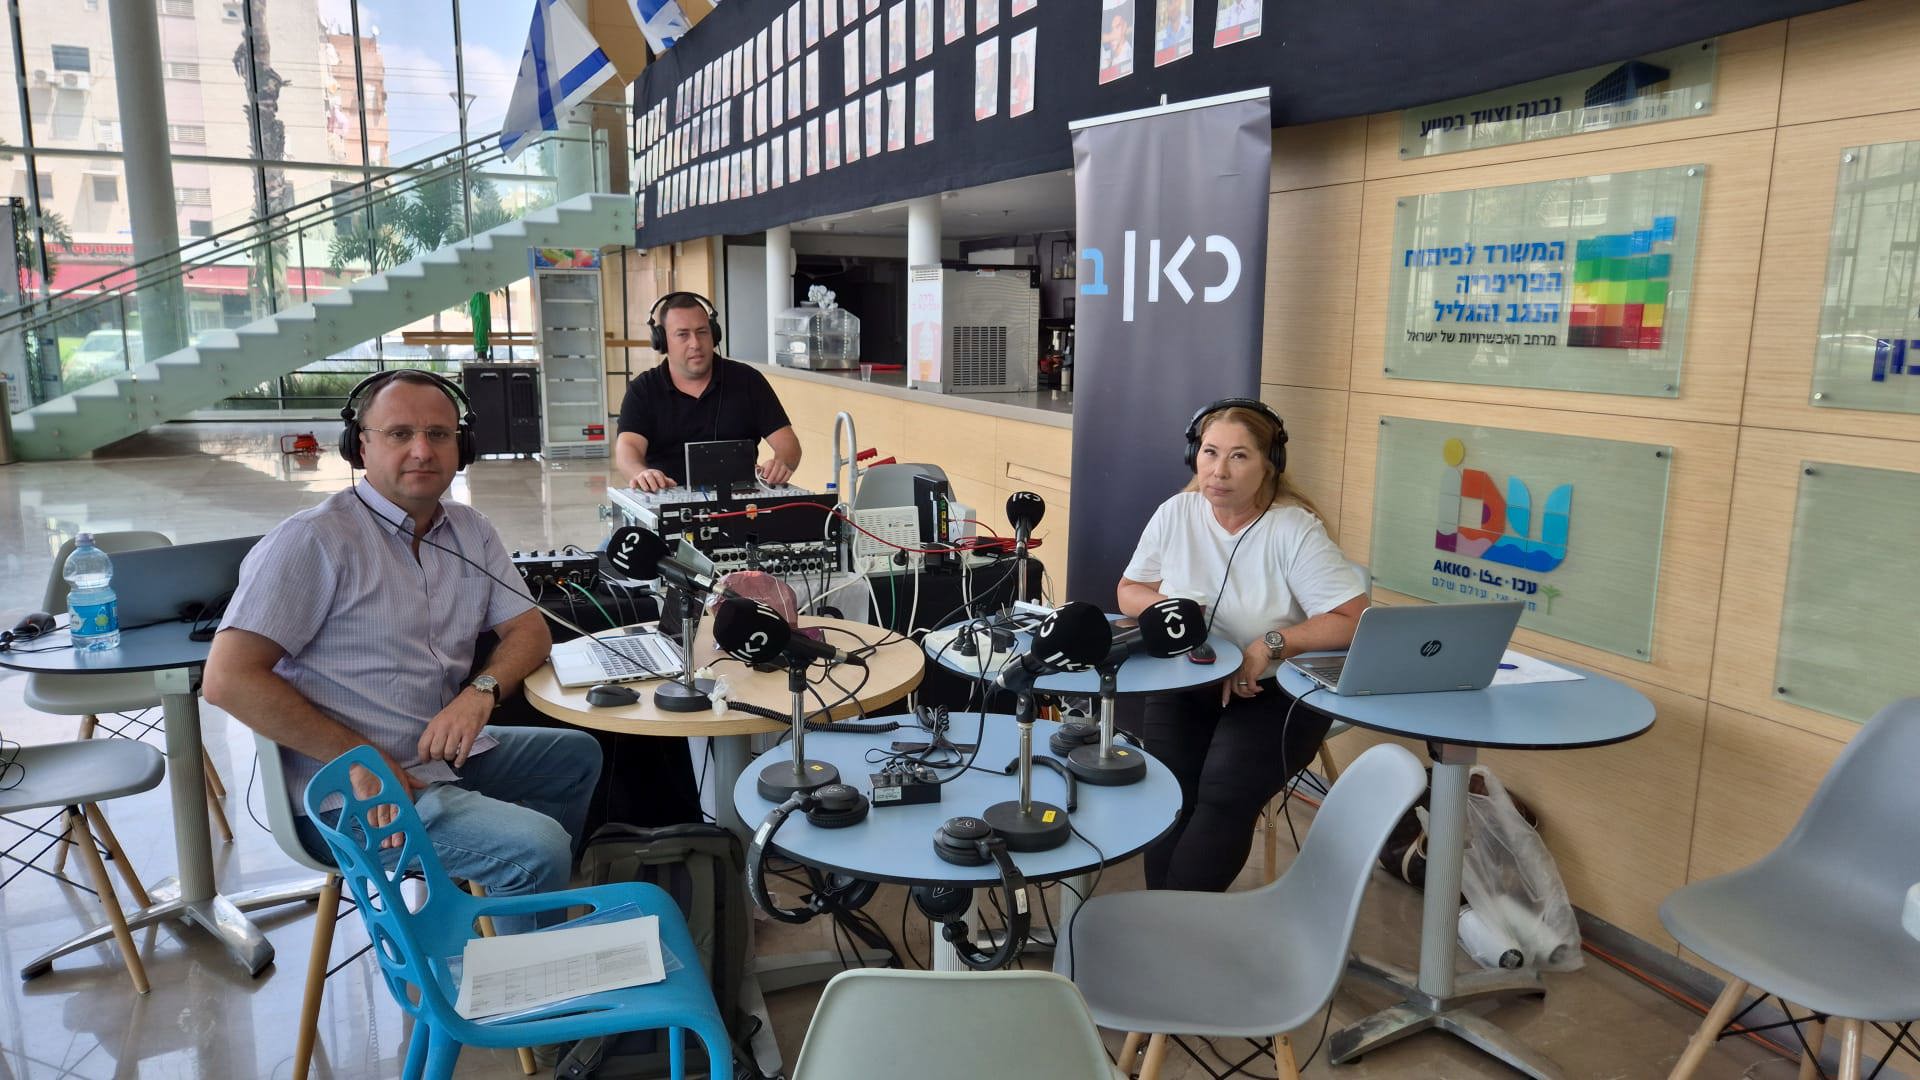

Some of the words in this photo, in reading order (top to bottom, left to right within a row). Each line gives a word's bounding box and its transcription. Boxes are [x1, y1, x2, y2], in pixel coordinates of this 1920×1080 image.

[1516, 96, 1563, 120] נבנה
[1404, 242, 1477, 267] לפיתוח
[1483, 241, 1566, 264] המשרד
[1080, 248, 1109, 295] ב
[1122, 230, 1242, 322] כאן
[1456, 272, 1562, 294] הפריפריה
[1434, 300, 1500, 322] והגליל
[1505, 303, 1560, 323] הנגב
[1406, 329, 1438, 342] ישראל
[1440, 330, 1456, 343] של
[1524, 333, 1556, 346] מרחב
[1433, 559, 1471, 579] AKKO
[1432, 576, 1455, 590] שלם
[1460, 583, 1488, 598] עולם
[1512, 577, 1538, 595] עכו
[1422, 640, 1440, 656] hp
